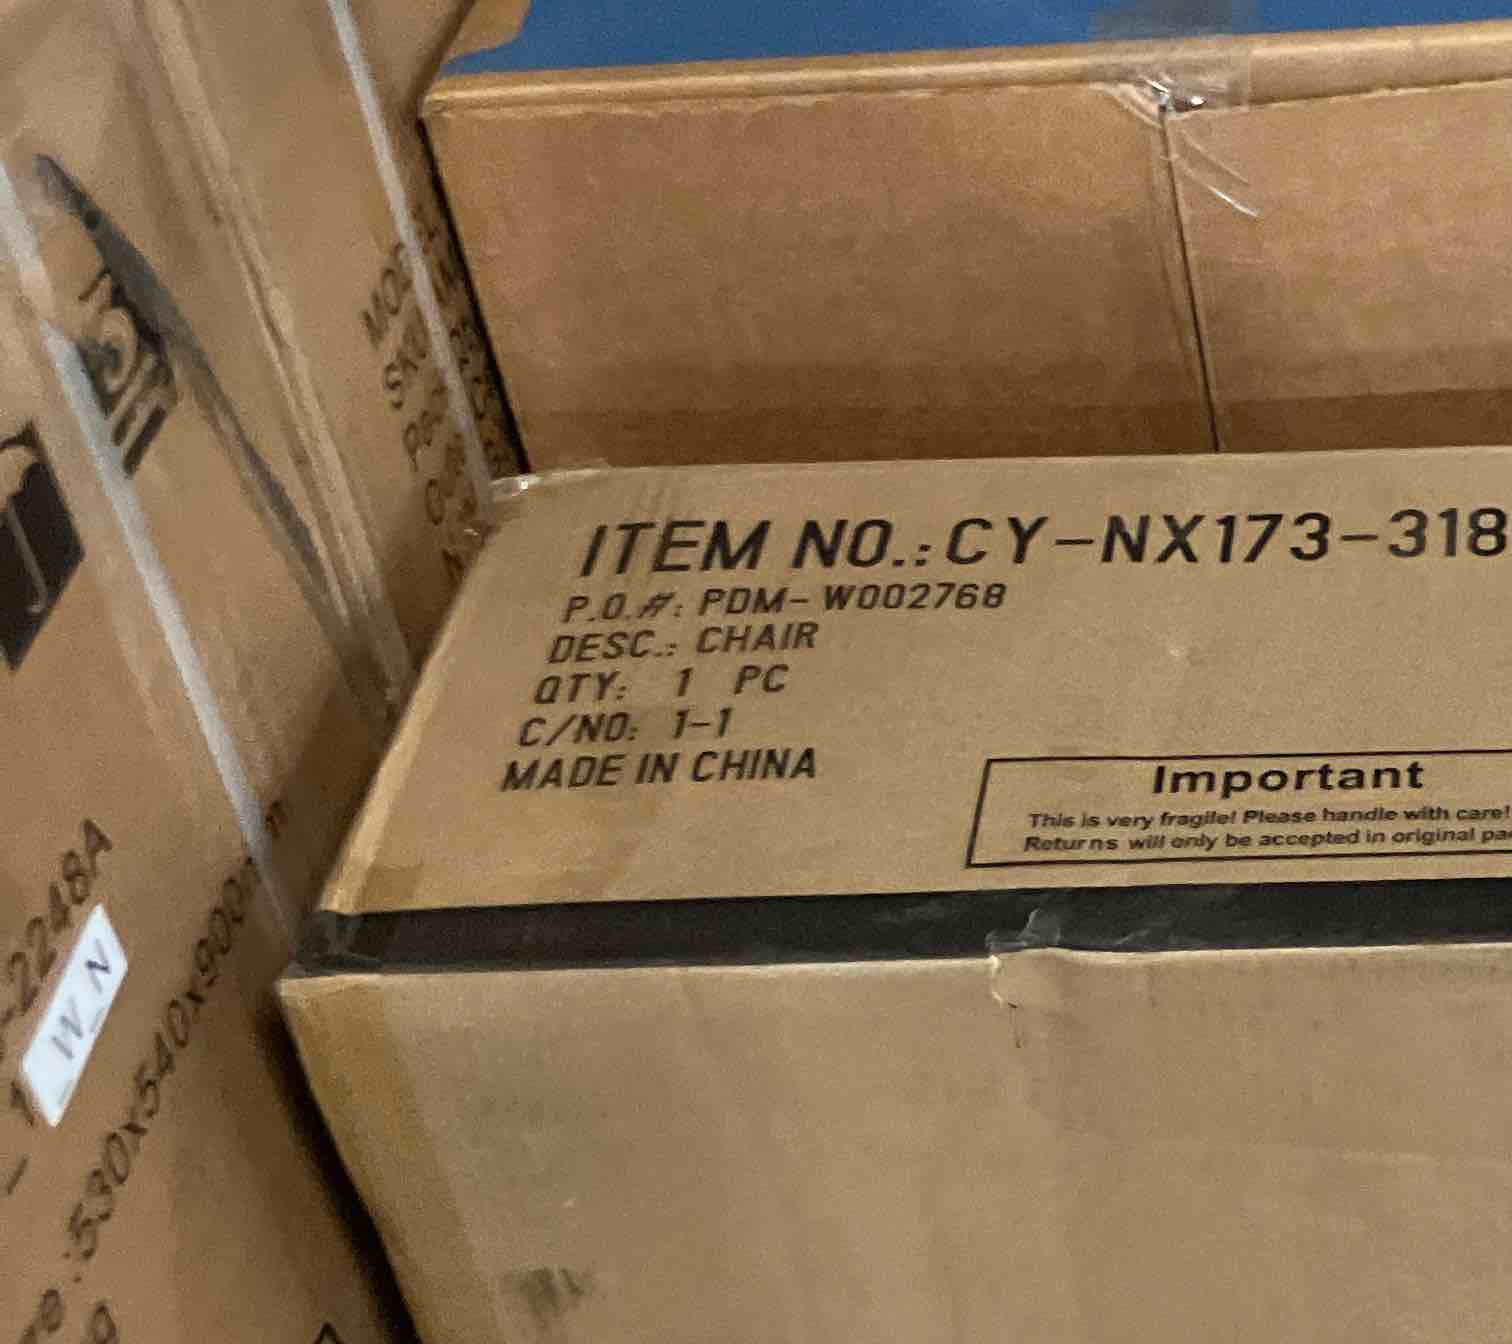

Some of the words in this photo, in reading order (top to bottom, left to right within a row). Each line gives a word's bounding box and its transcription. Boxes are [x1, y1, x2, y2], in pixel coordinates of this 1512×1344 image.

[580, 519, 771, 577] ITEM
[561, 591, 684, 624] P.O.#:
[548, 629, 677, 665] DESC.:
[696, 621, 820, 654] CHAIR
[534, 671, 628, 705] QTY:
[676, 667, 694, 698] 1
[733, 663, 790, 695] PC
[518, 712, 637, 748] C/NO:
[672, 707, 734, 740] 1-1
[500, 755, 624, 792] MADE
[635, 751, 677, 784] IN
[691, 747, 818, 782] CHINA
[1153, 761, 1424, 799] Important
[1028, 812, 1075, 829] This
[1081, 811, 1100, 828] is
[1106, 814, 1152, 830] very
[1242, 808, 1317, 824] Please
[1322, 806, 1399, 822] handle
[1403, 805, 1450, 821] with
[1456, 804, 1512, 821] care!
[1024, 835, 1119, 852] Returns
[1128, 834, 1166, 850] will
[1171, 833, 1218, 852] only
[1224, 832, 1253, 847] be
[1258, 828, 1361, 847] accepted
[1365, 828, 1386, 844] in
[1391, 827, 1476, 846] original
